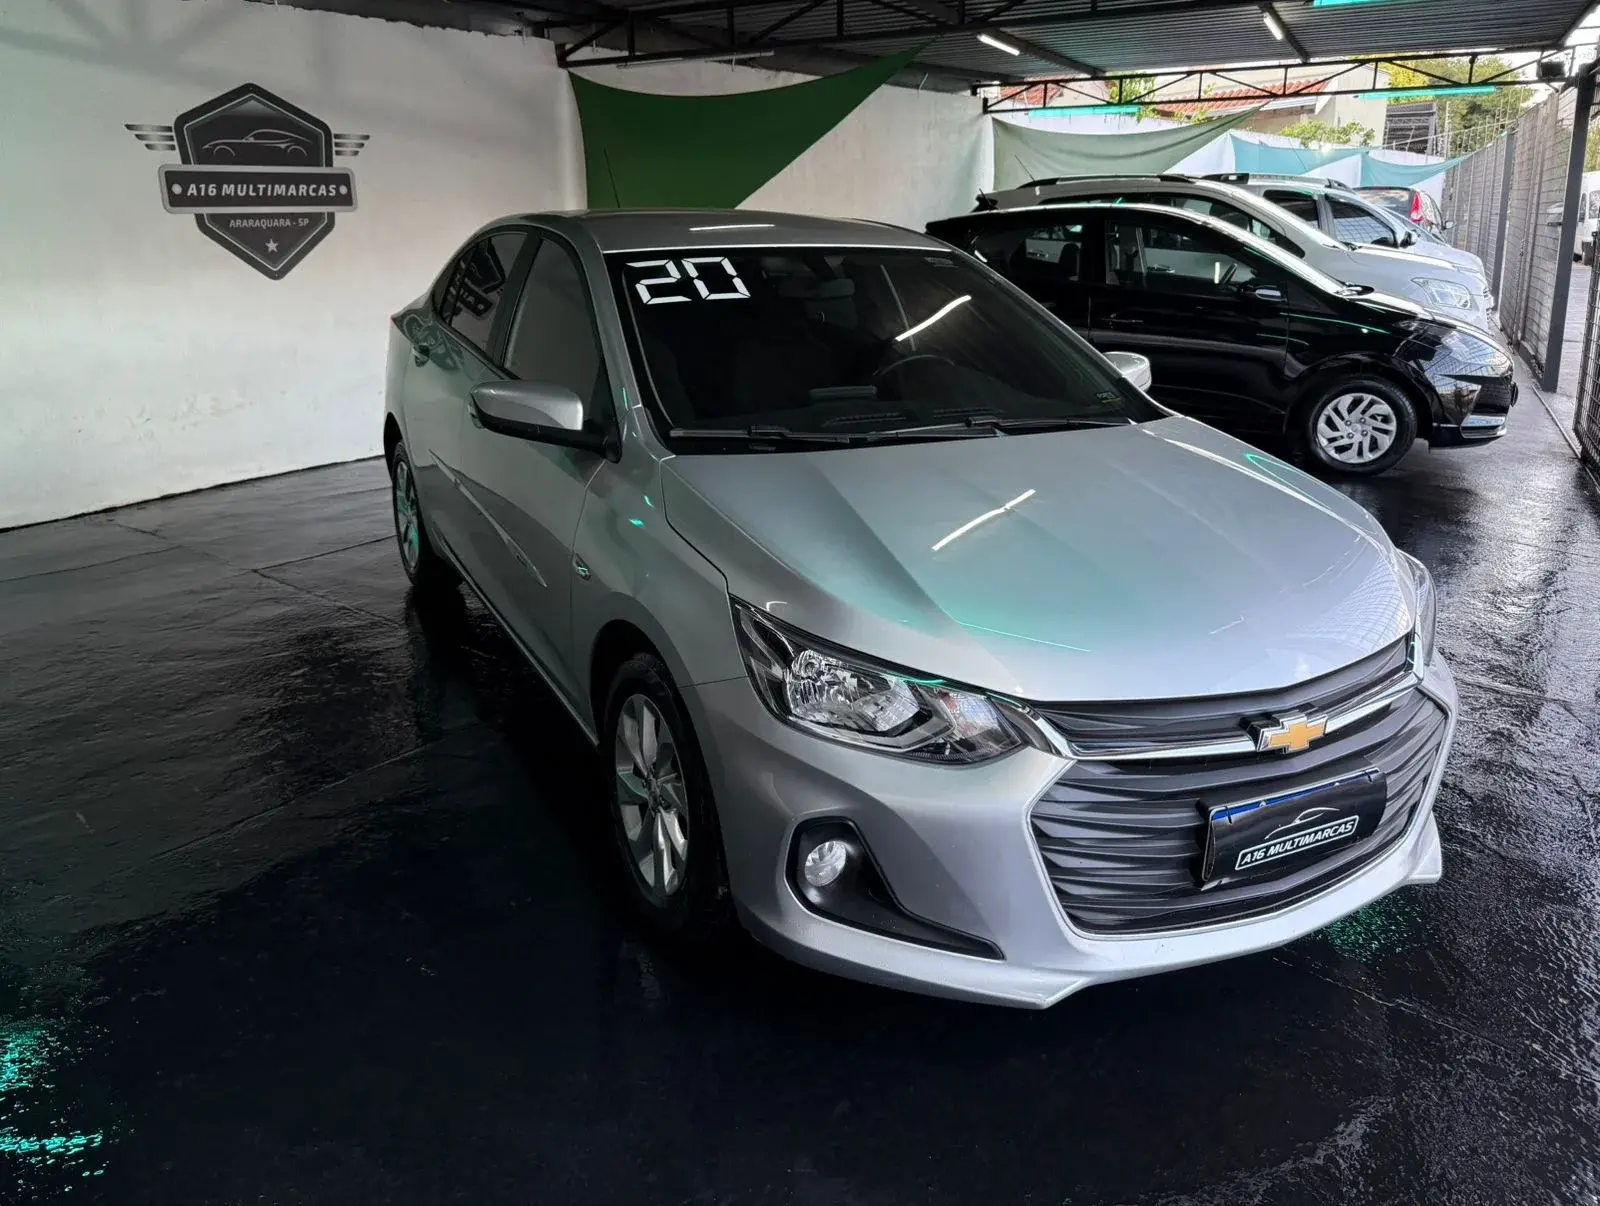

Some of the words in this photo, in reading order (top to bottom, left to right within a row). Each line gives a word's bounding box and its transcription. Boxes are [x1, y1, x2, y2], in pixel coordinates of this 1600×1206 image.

[187, 184, 217, 197] A16
[222, 184, 337, 197] MULTIMARCAS
[229, 217, 291, 229] ARARAQUARA
[298, 218, 310, 227] SP
[626, 257, 751, 304] 20
[1241, 847, 1265, 865] A16
[1267, 821, 1354, 856] MULTIMARCAS
